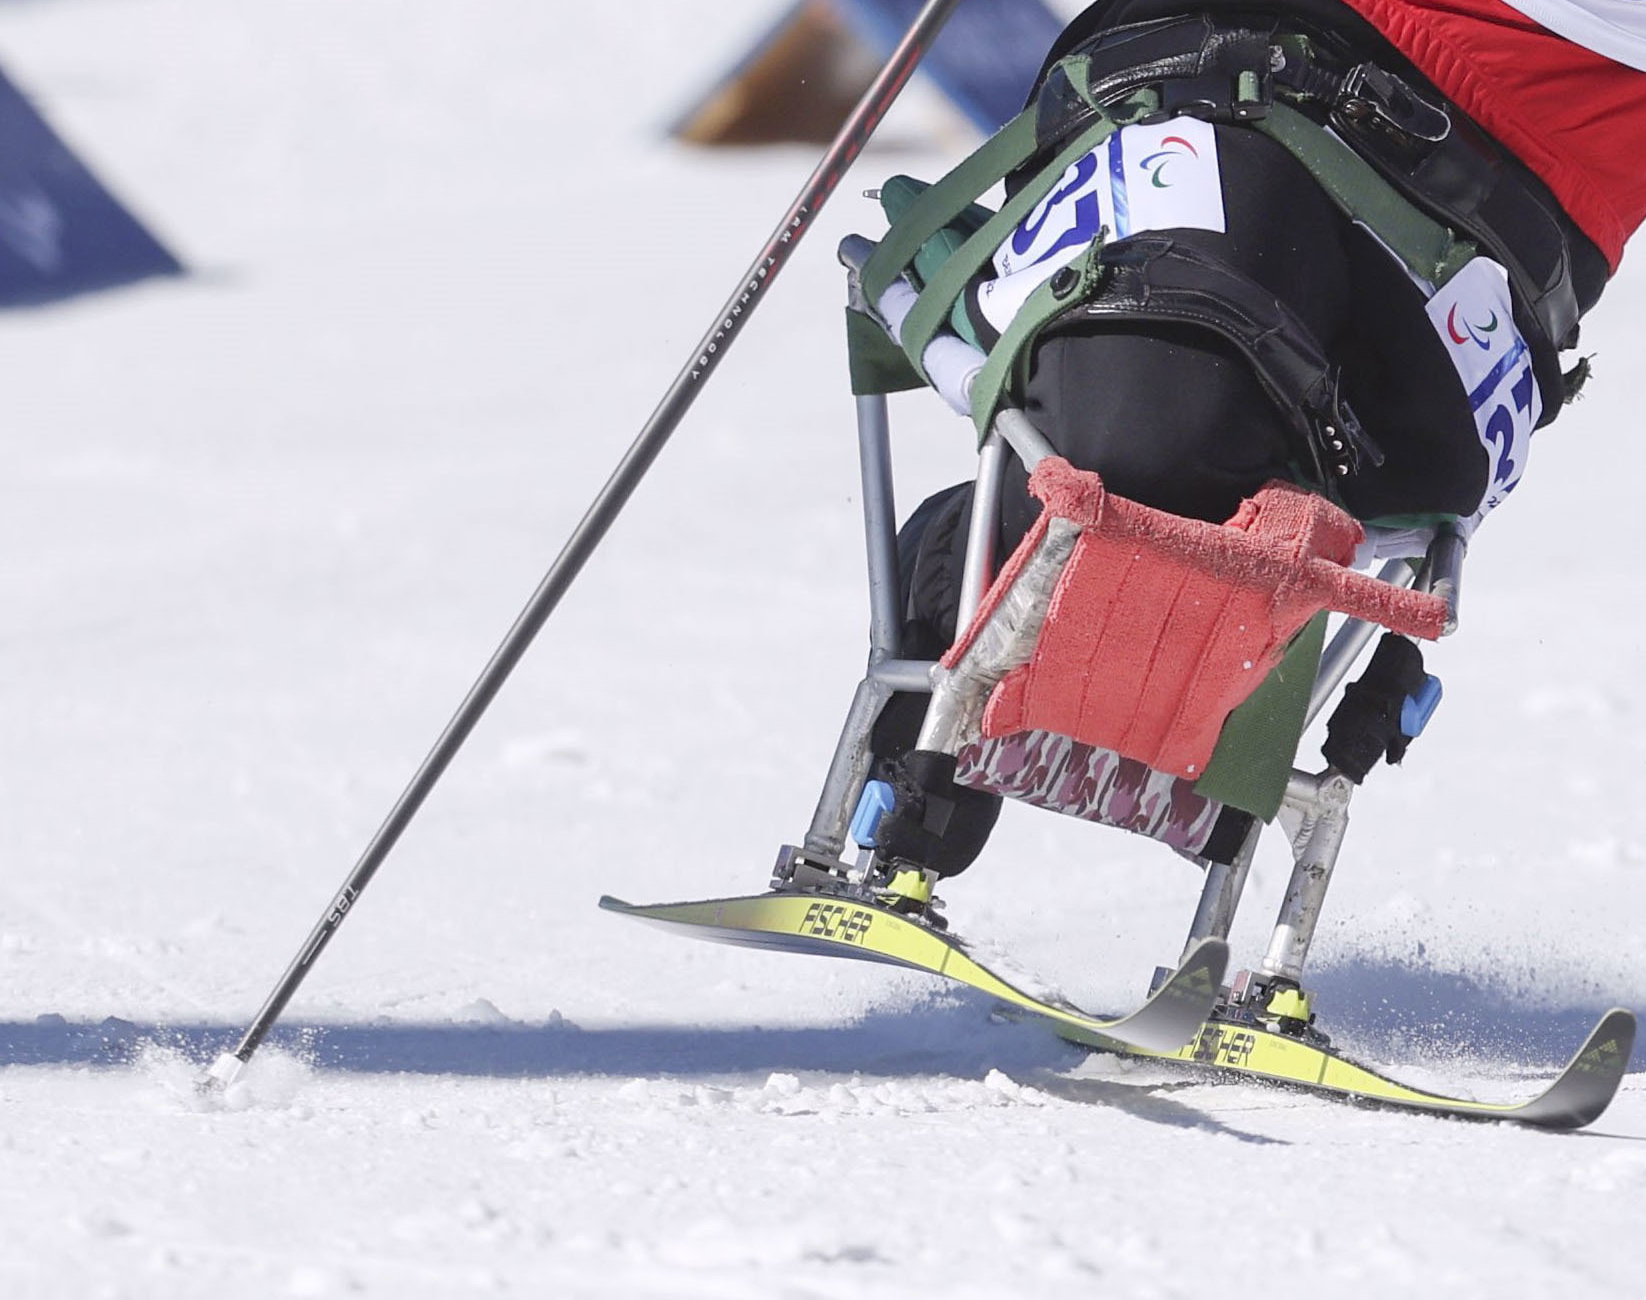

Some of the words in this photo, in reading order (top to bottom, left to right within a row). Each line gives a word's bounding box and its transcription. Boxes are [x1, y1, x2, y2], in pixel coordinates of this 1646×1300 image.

[1011, 152, 1101, 267] 37
[692, 257, 776, 380] TECHNOLOGY
[798, 902, 874, 945] FISCHER
